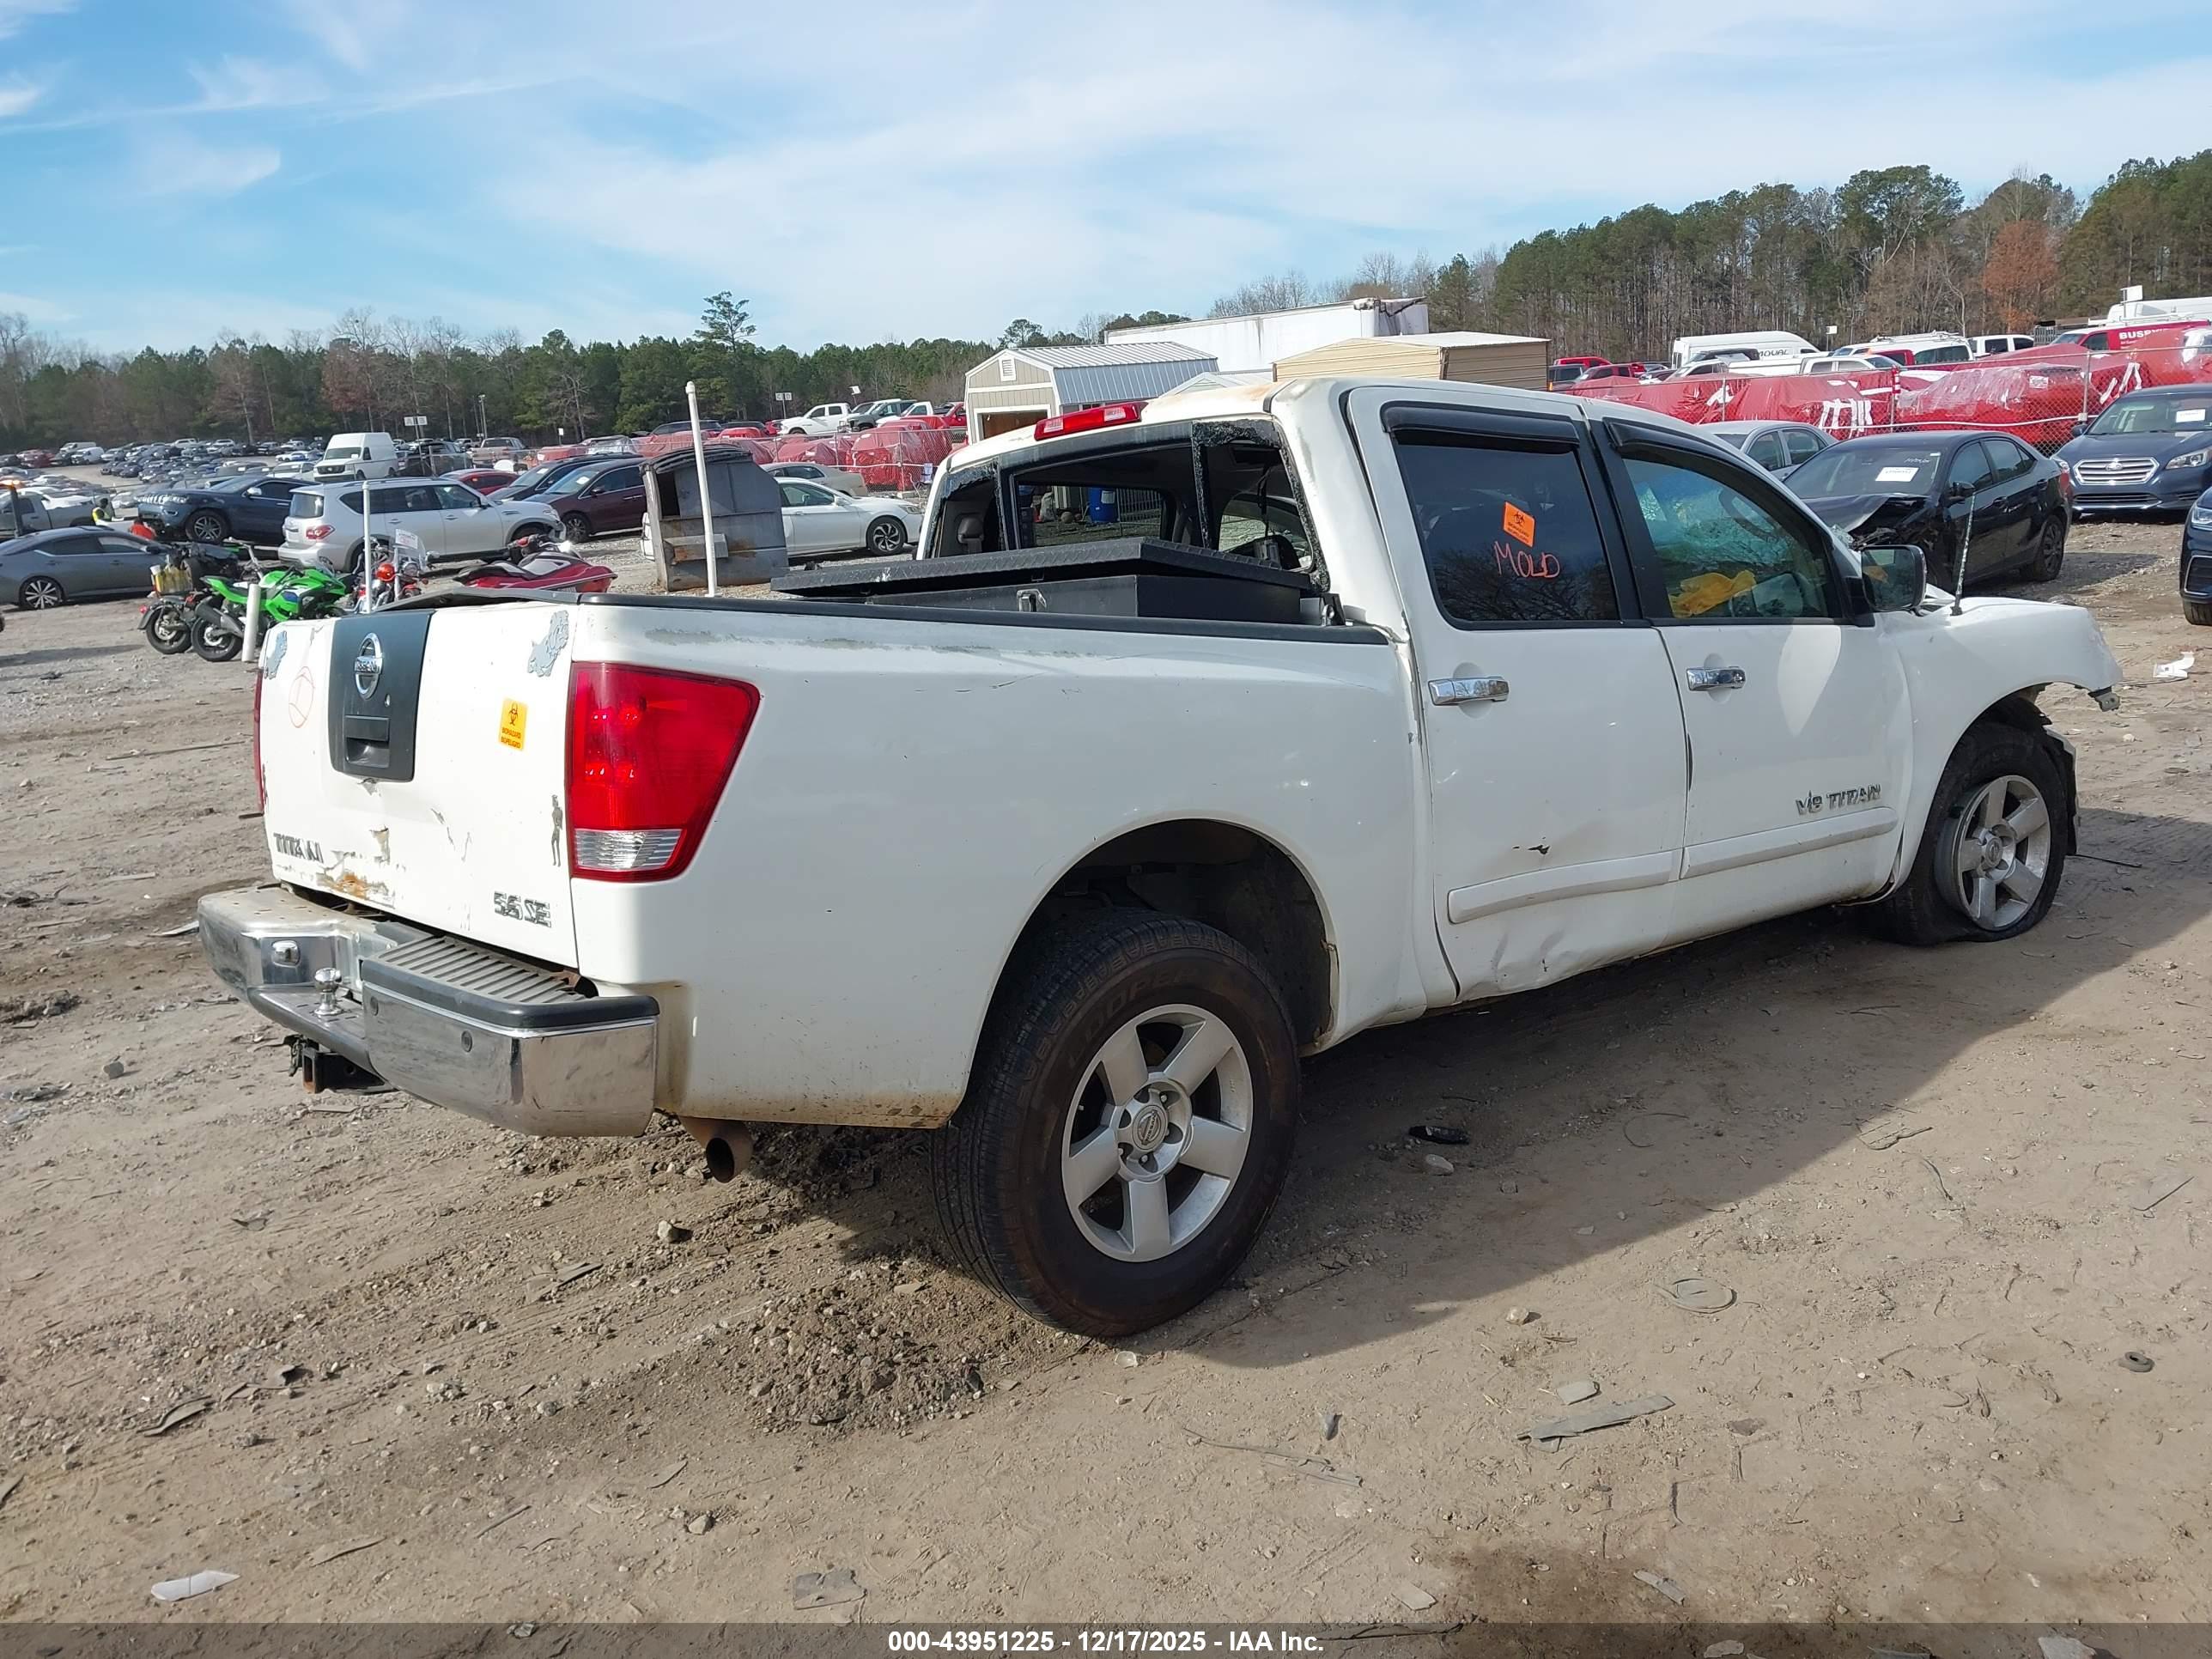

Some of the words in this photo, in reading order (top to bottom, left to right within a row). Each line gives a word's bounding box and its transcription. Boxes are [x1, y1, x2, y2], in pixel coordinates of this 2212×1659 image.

[1493, 540, 1560, 578] MOLD
[1796, 790, 1823, 816] V8
[1826, 784, 1881, 810] TITAN
[273, 831, 325, 864] TITAN
[524, 898, 551, 927] SE
